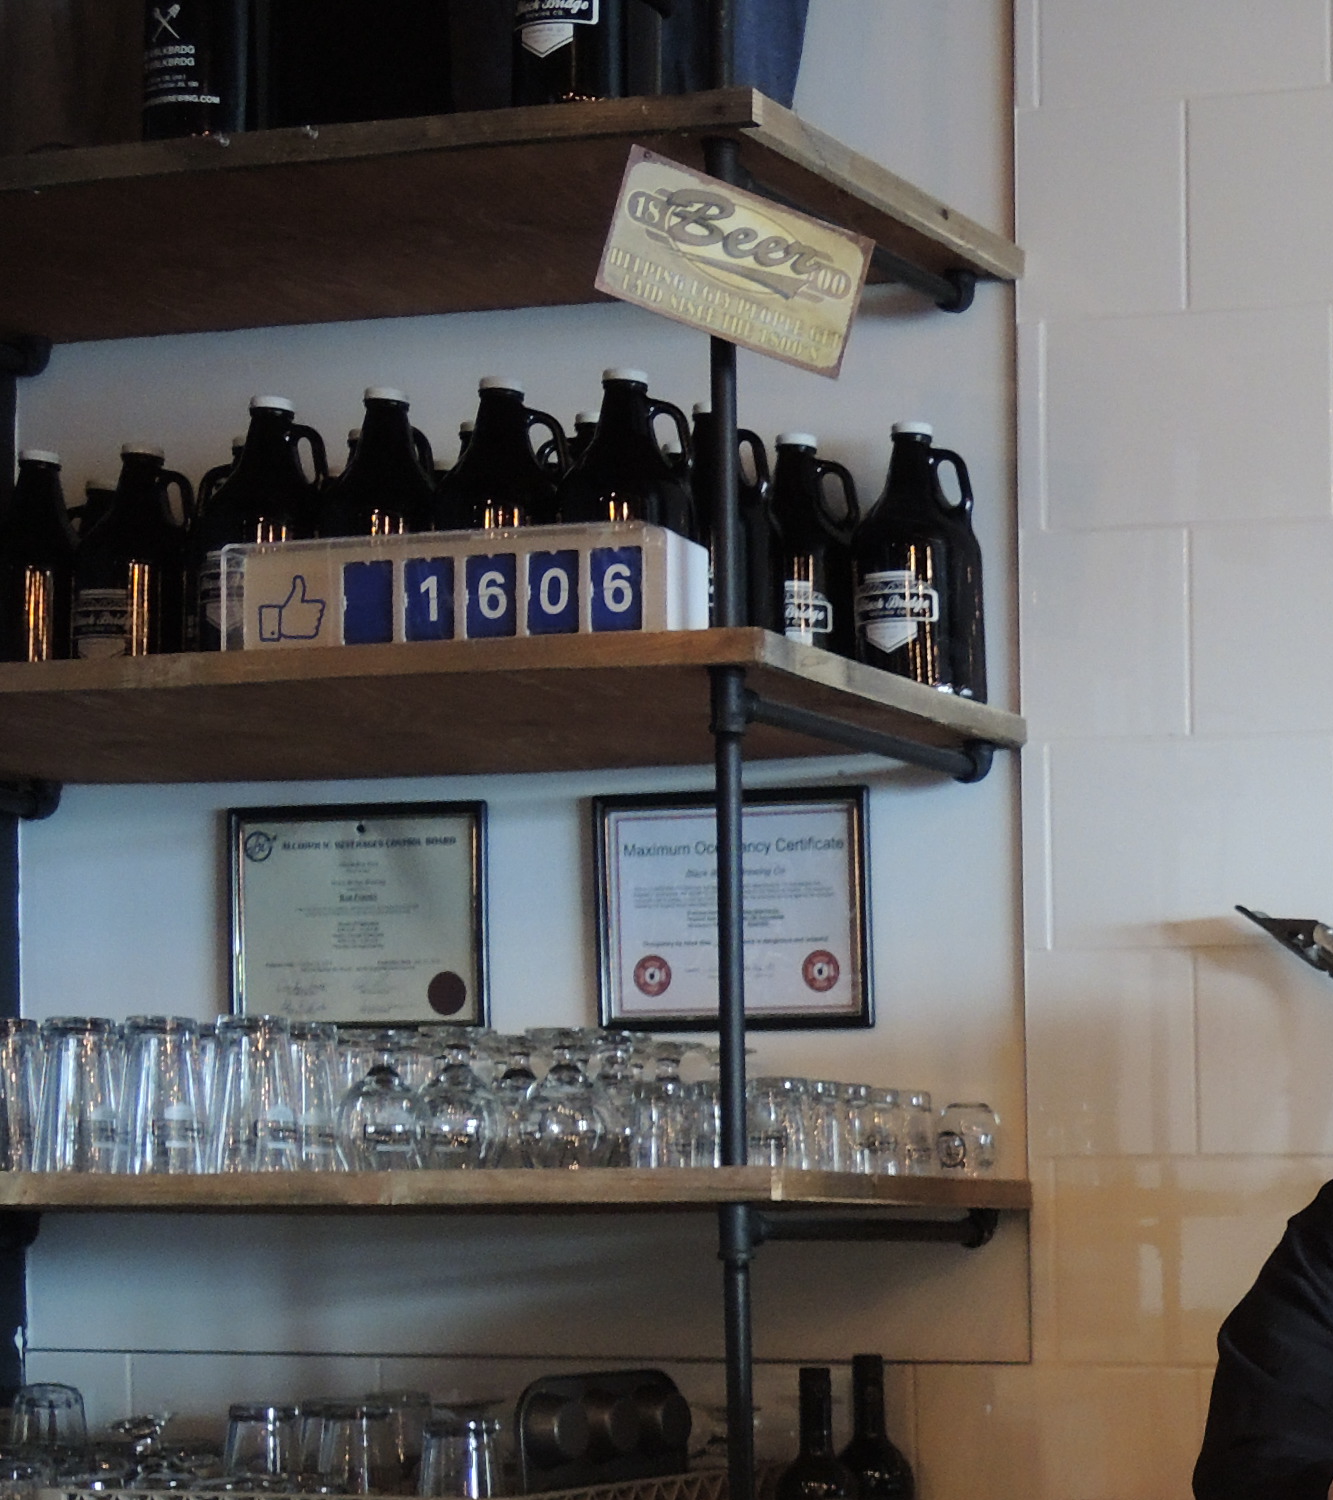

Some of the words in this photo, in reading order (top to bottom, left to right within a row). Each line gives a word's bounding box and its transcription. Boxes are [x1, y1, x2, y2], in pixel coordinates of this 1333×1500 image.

[667, 188, 827, 276] Beer
[736, 298, 803, 334] PEOPLE
[623, 843, 688, 857] Maximum
[775, 836, 845, 851] Certificate
